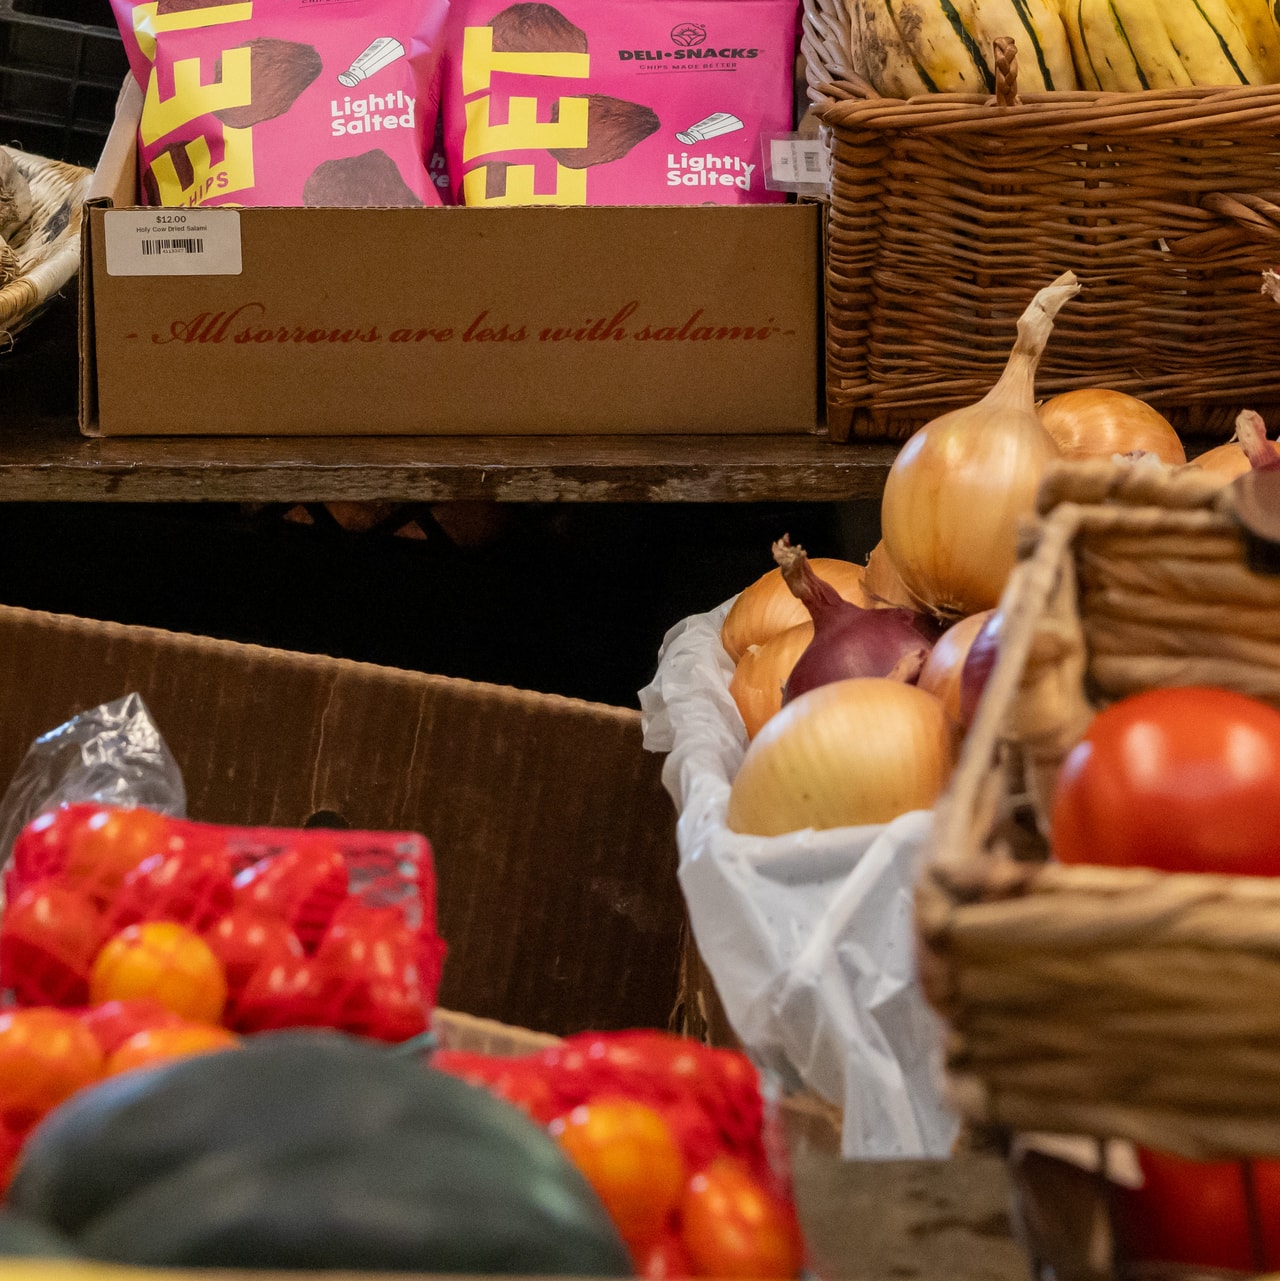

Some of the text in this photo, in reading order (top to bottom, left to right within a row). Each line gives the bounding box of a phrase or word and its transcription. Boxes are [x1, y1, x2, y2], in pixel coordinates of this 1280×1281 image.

[331, 90, 417, 117] Lightly
[331, 111, 416, 137] Salted
[667, 152, 756, 175] Lightly
[178, 171, 229, 207] HIPS
[666, 170, 751, 192] Salted
[136, 226, 151, 234] Holy
[156, 215, 187, 224] $12.00
[151, 300, 775, 345] All sorrows are less with salami
